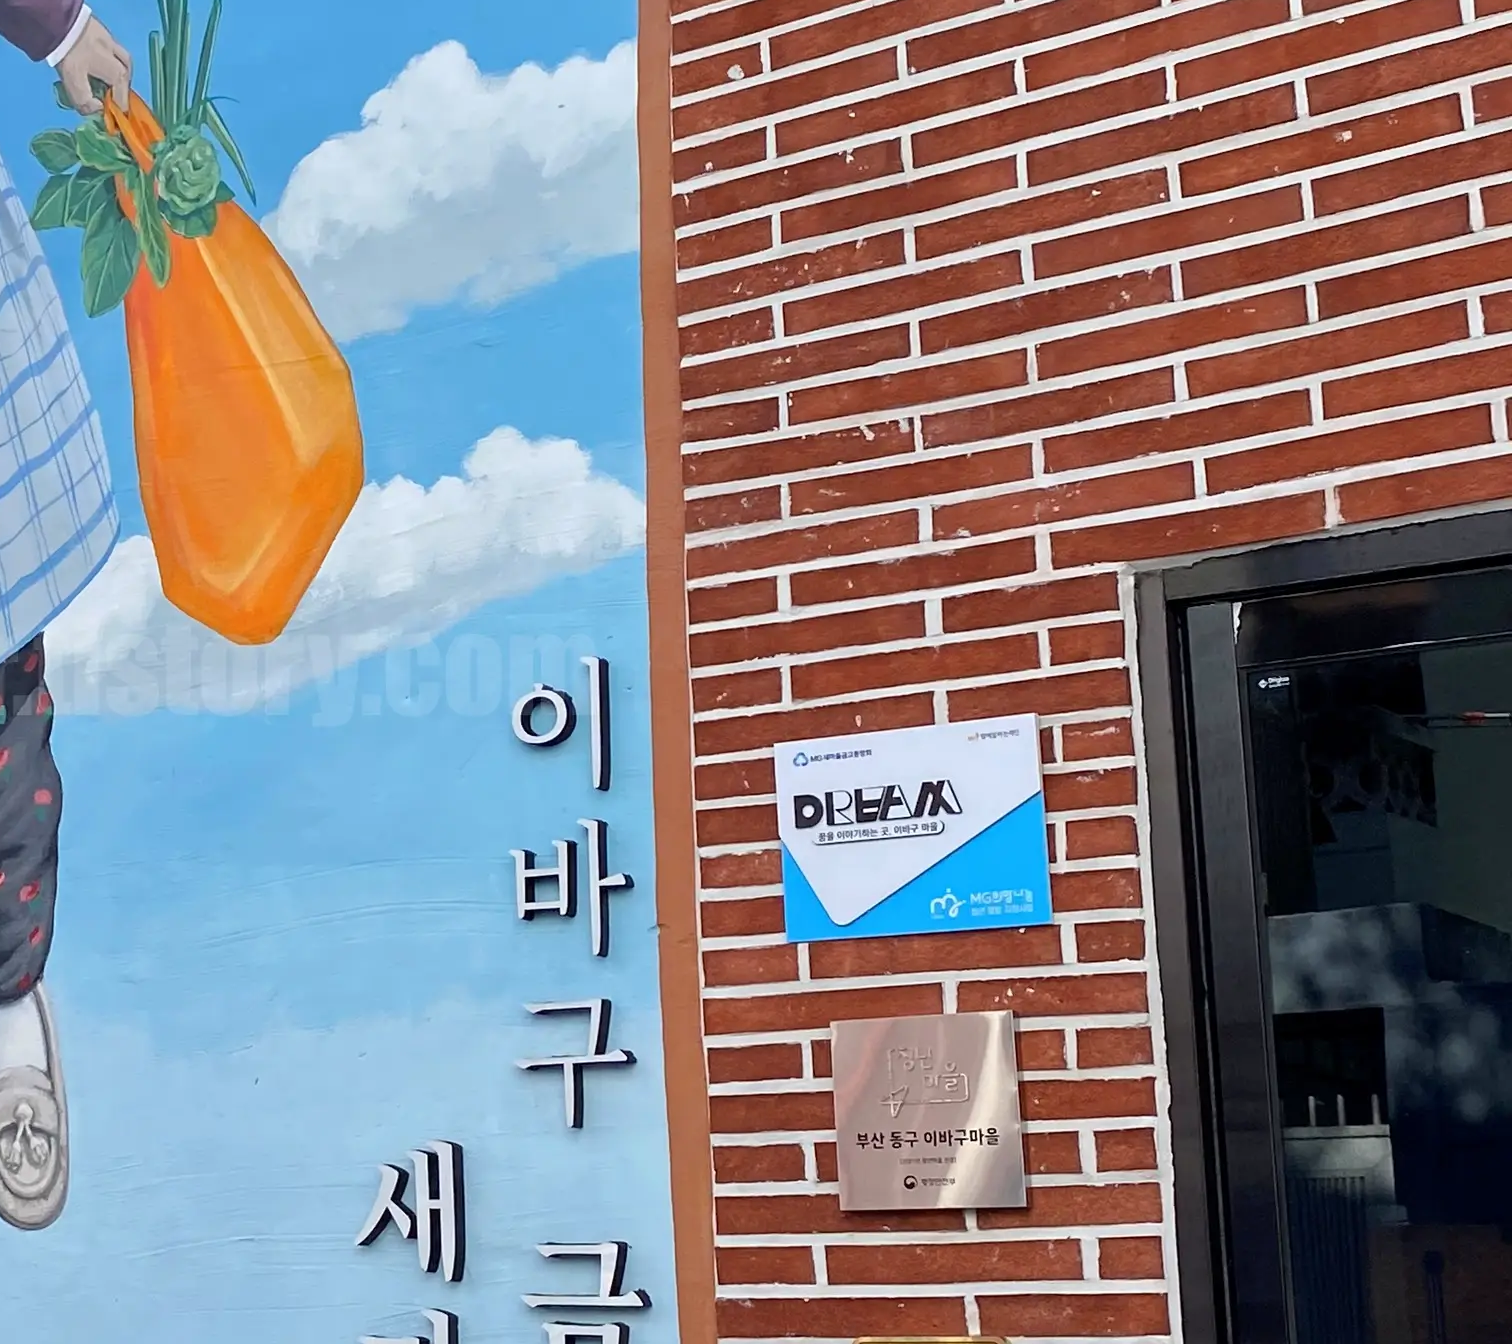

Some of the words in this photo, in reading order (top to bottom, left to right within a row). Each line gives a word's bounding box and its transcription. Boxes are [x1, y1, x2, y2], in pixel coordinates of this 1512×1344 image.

[793, 779, 963, 829] DREAM
[836, 828, 879, 840] 이야기하는
[893, 824, 919, 835] 이바구
[921, 821, 939, 833] 마을
[511, 655, 636, 1130] 이바구
[855, 1132, 885, 1150] 부산
[889, 1130, 919, 1149] 동구
[923, 1127, 1000, 1147] 이바구마을
